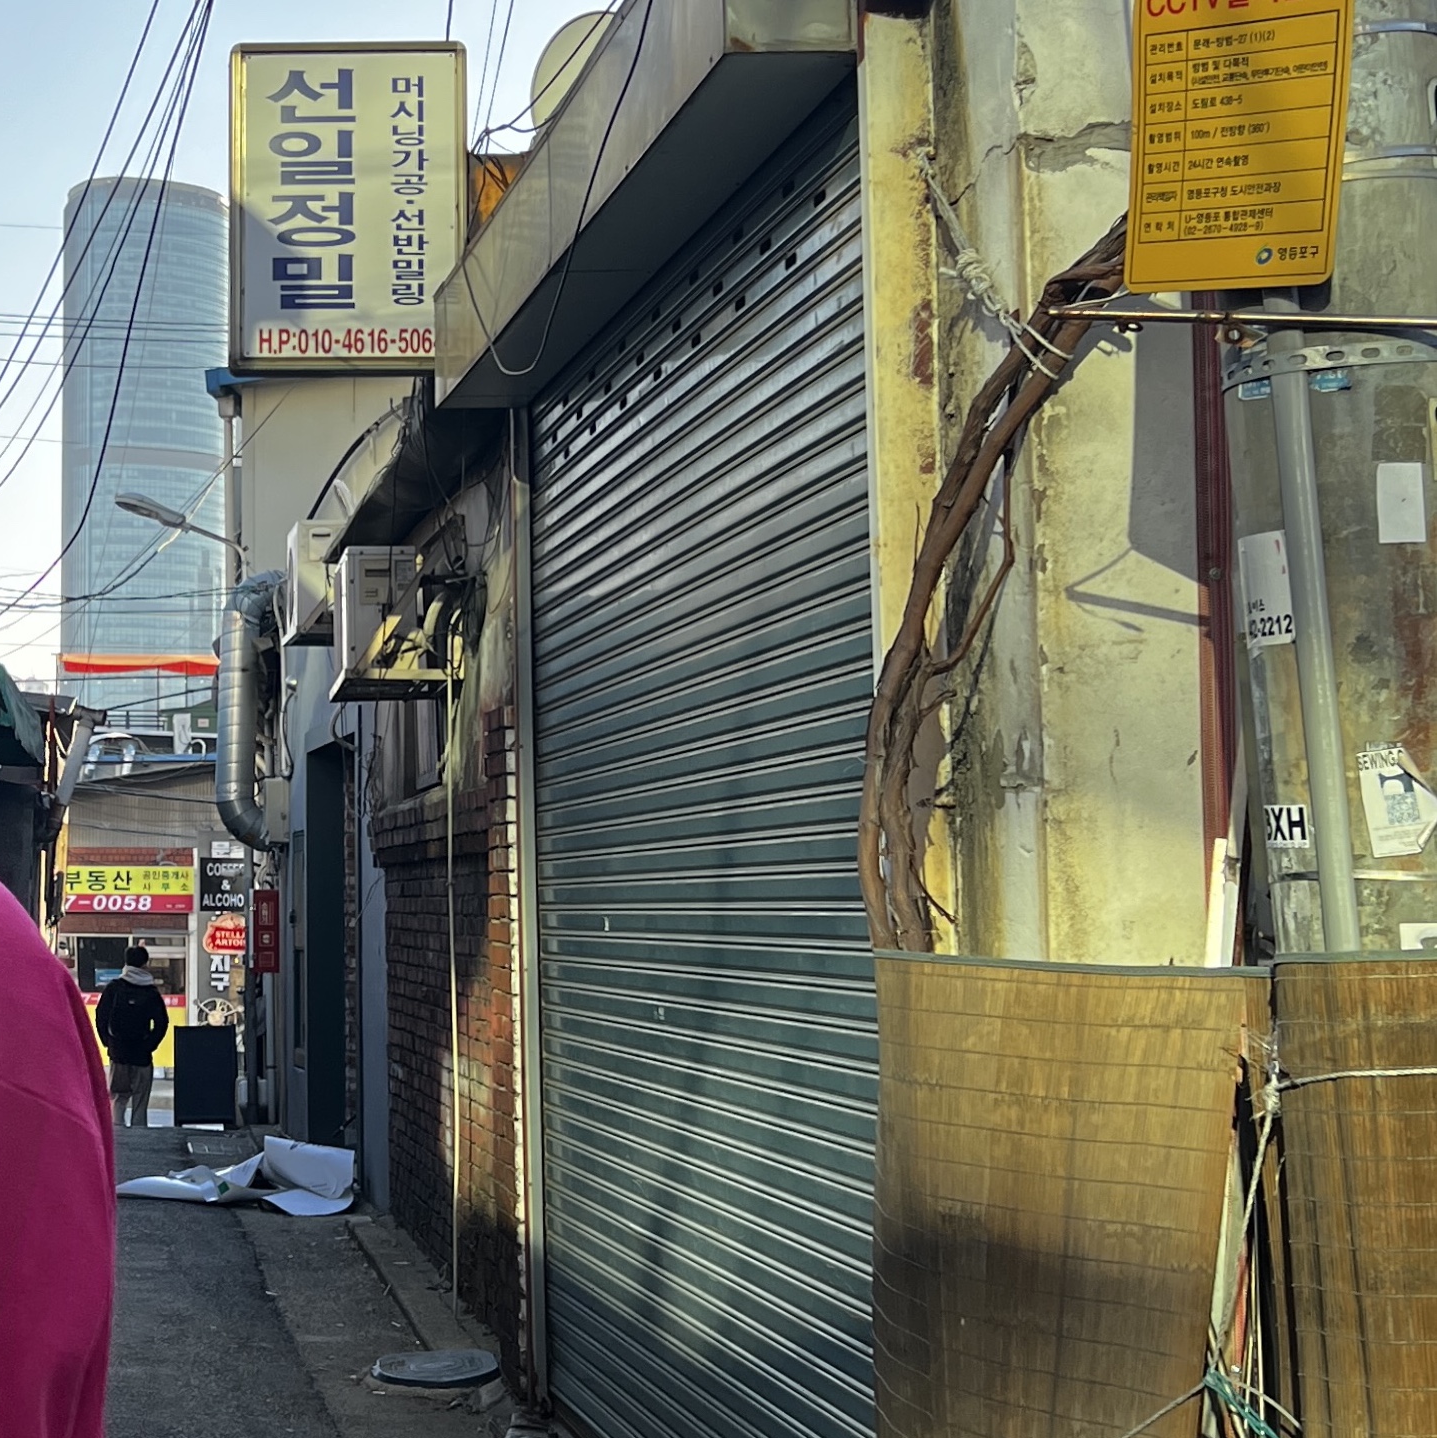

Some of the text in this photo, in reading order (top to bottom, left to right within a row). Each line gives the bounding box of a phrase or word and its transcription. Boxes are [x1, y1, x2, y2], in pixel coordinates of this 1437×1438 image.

[266, 68, 357, 310] 선일정밀
[1276, 245, 1320, 261] 영등포구
[258, 328, 435, 355] H.P:010-4616-506
[66, 870, 133, 892] 부동산
[220, 879, 231, 891] &
